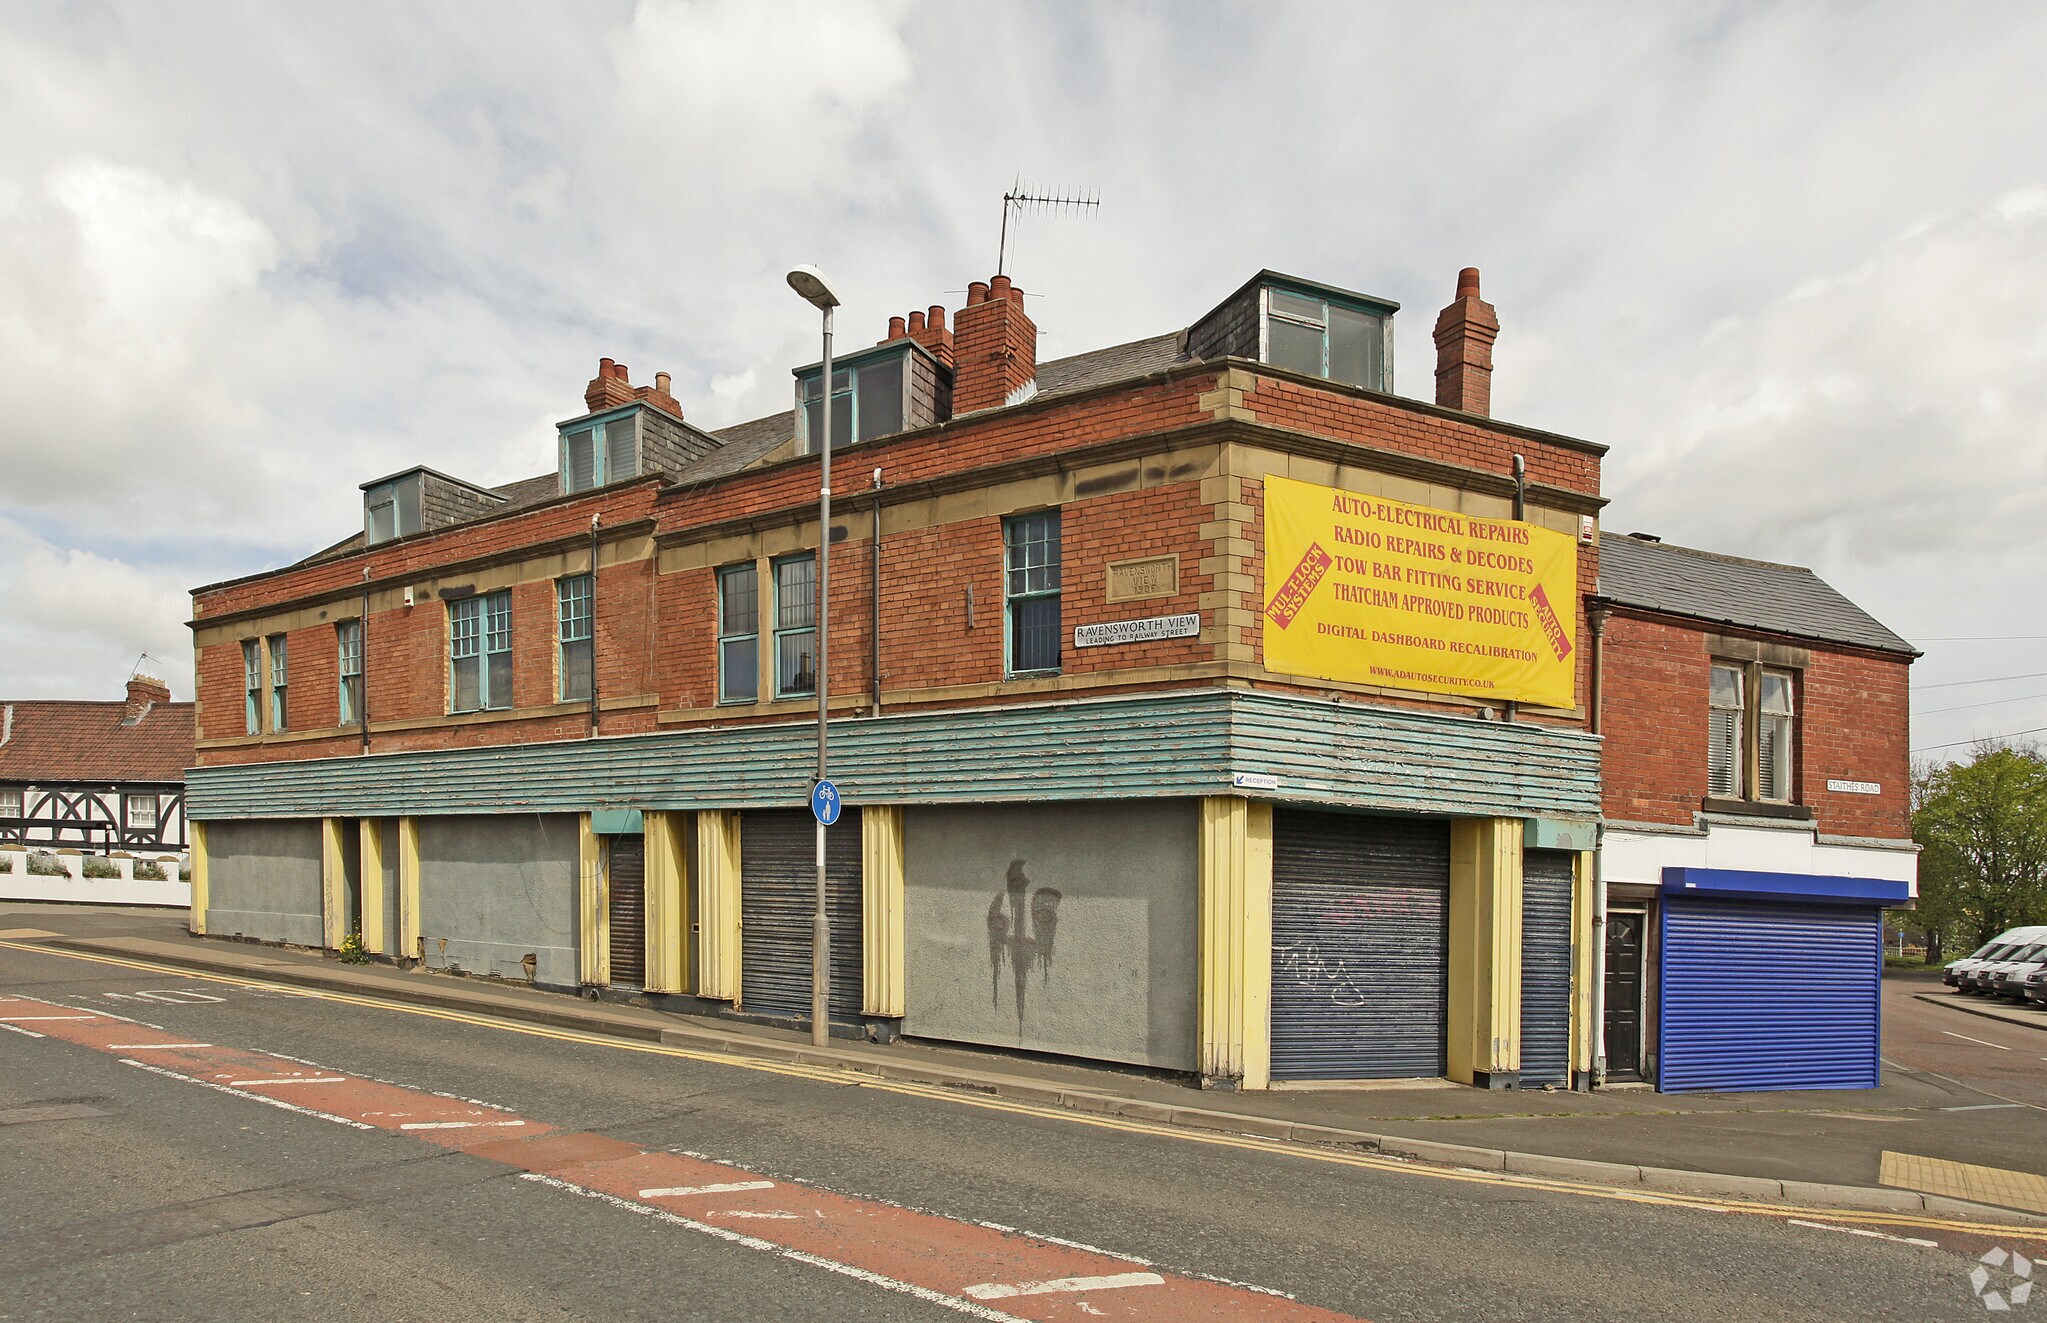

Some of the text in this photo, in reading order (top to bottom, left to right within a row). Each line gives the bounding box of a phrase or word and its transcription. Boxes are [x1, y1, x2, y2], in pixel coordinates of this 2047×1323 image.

[1332, 495, 1529, 546] AUTO-ELECTRICAL REPAIRS
[1334, 525, 1534, 575] RADIO REPAIRS & DECODES
[1113, 562, 1173, 578] RAVENSWORTH
[1133, 575, 1158, 586] VIEW
[1267, 545, 1323, 620] MUL-T-LOCK
[1335, 555, 1526, 601] TOW BAR FITTING SERVICE
[1283, 563, 1325, 620] SYSTEMS
[1333, 582, 1529, 629] THATCHAM APPROVED PRODUCTS
[1077, 616, 1197, 638] RAVENSWORTH VIEW
[1086, 636, 1115, 645] LEADING
[1129, 631, 1158, 640] RAILWAY
[1161, 628, 1188, 638] STREET
[1531, 596, 1563, 656] SECURITY
[1542, 605, 1561, 638] AUTO
[1317, 622, 1538, 663] DIGITAL DASHBOARD RECALIBRATION
[1369, 665, 1495, 689] WWW.ADAUTOSECURITY.CO.UK
[1245, 777, 1276, 785] RECEPTION
[1828, 781, 1880, 793] STAITHES ROAD
